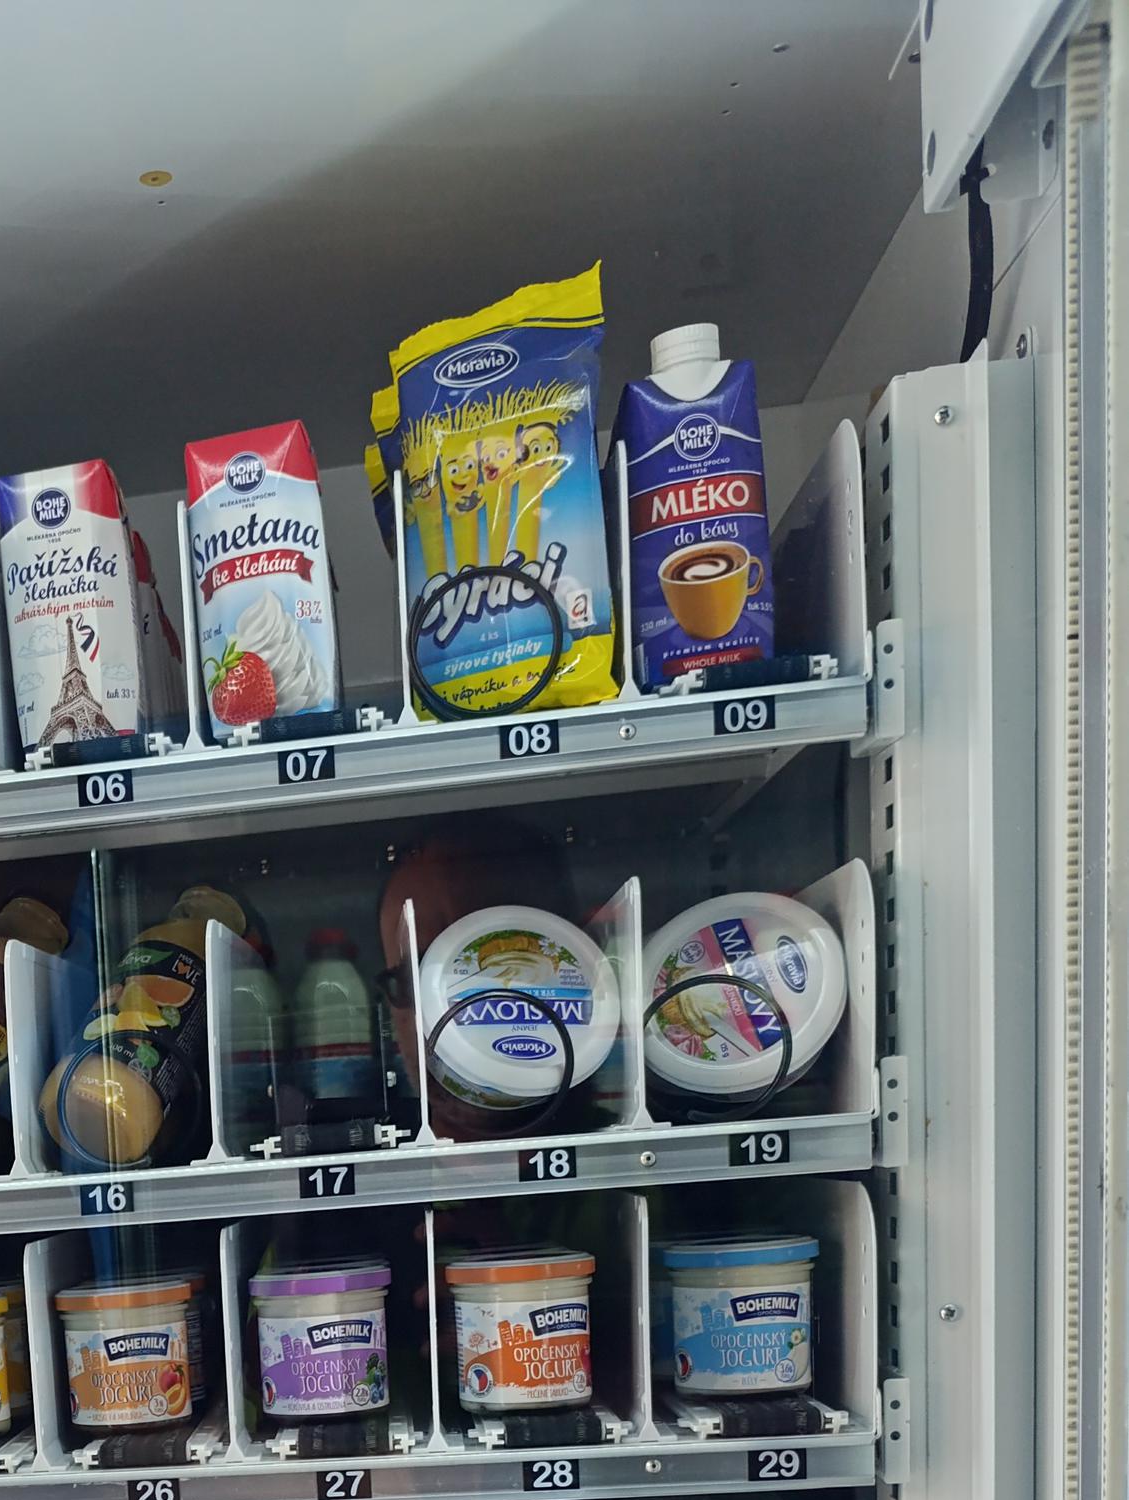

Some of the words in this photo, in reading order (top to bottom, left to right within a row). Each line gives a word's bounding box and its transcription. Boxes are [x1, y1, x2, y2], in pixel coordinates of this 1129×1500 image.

[447, 351, 506, 378] Moravia
[680, 424, 714, 441] BOHE
[682, 435, 712, 450] MILK
[229, 461, 260, 477] BOHE
[232, 472, 259, 487] MILK
[36, 496, 66, 511] BOHE
[651, 477, 750, 524] MLÉKO
[39, 507, 66, 522] MILK
[192, 513, 320, 579] Smetana
[674, 526, 695, 547] do
[700, 520, 739, 546] kávy
[7, 547, 118, 596] Pařížská
[211, 570, 230, 589] ke
[234, 555, 298, 581] šlehání
[23, 574, 99, 604] šlehačka
[682, 657, 716, 669] WHOLE
[718, 653, 741, 663] MILK
[723, 699, 768, 732] 09
[508, 723, 552, 756] 08
[285, 749, 327, 782] 07
[85, 772, 126, 804] 06
[502, 1043, 546, 1054] Moravia
[740, 1134, 783, 1163] 19
[528, 1150, 571, 1180] 18
[308, 1167, 348, 1197] 17
[88, 1184, 127, 1213] 16
[534, 1305, 587, 1328] BOHEMILK
[736, 1297, 798, 1314] BOHEMILK
[108, 1335, 166, 1355] BOHEMILK
[311, 1321, 372, 1343] BOHEMILK
[522, 1359, 577, 1382] JOGURT
[720, 1347, 781, 1368] JOGURT
[99, 1385, 152, 1407] JOGURT
[299, 1373, 357, 1395] JOGURT
[532, 1461, 573, 1489] 28
[757, 1450, 800, 1478] 29
[324, 1470, 366, 1498] 27
